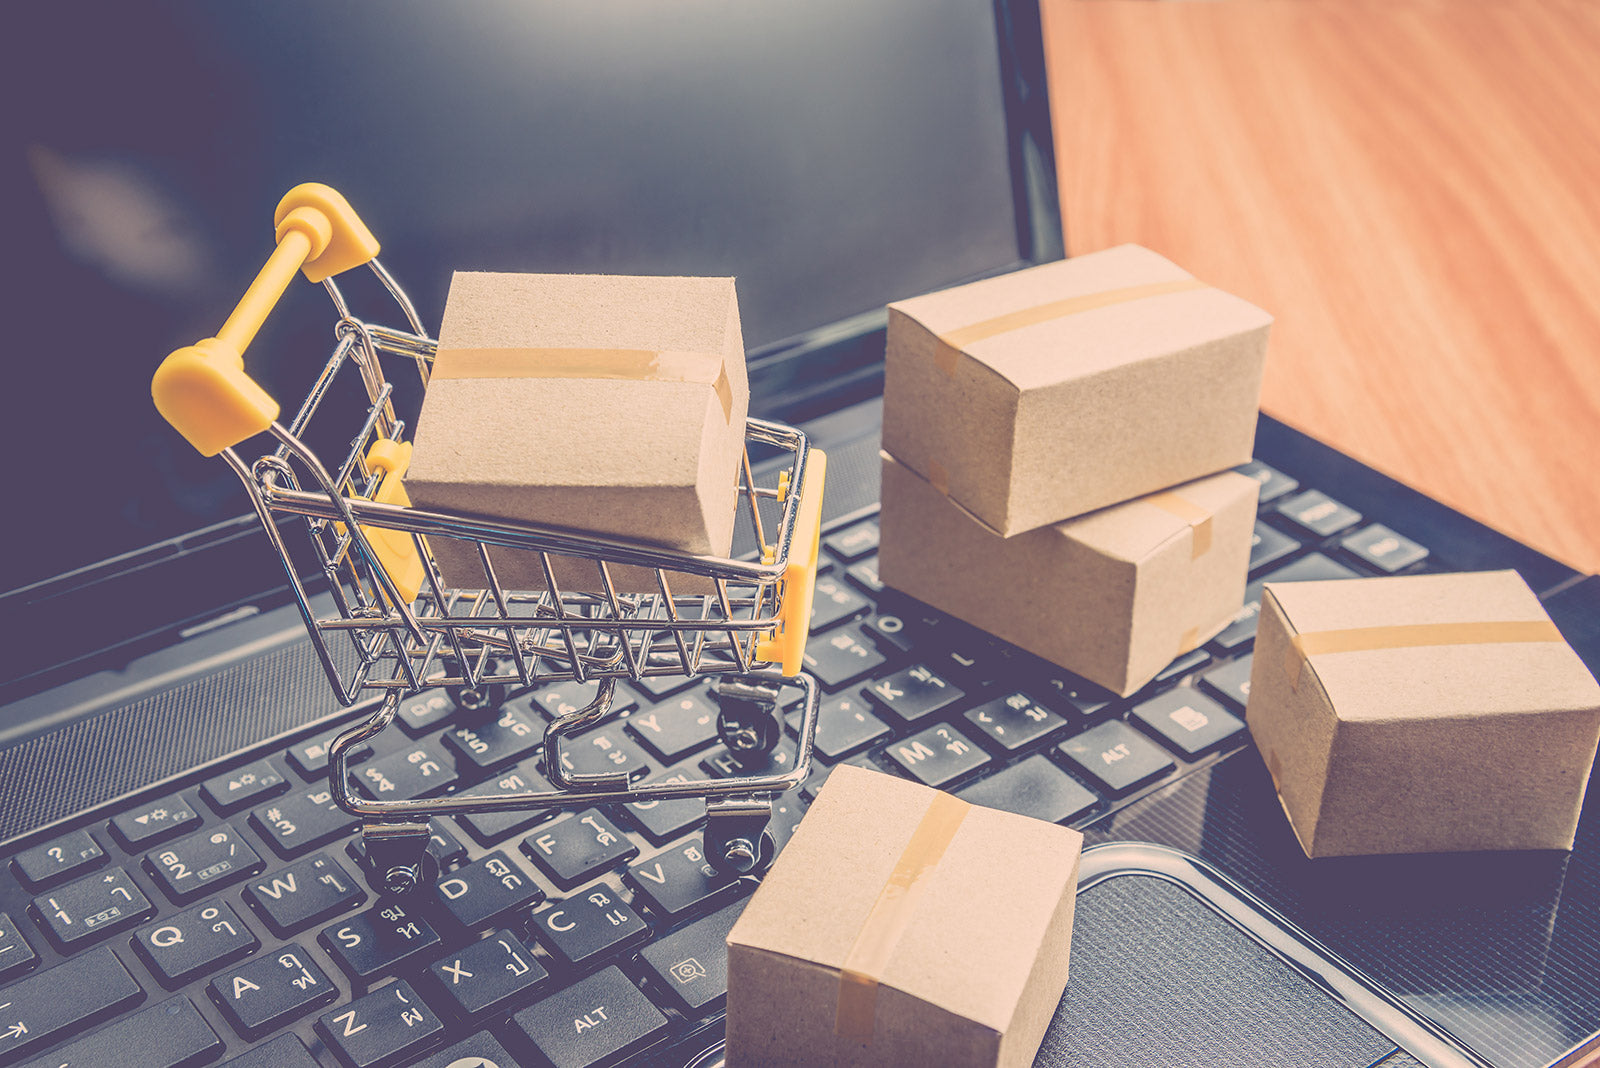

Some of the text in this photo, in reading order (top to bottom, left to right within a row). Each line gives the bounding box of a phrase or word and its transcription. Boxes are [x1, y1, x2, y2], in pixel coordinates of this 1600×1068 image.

[878, 616, 904, 633] O
[951, 652, 975, 666] L
[875, 681, 904, 701] K
[638, 714, 661, 732] Y
[468, 739, 489, 754] 5
[898, 741, 935, 765] M
[1101, 743, 1131, 765] ALT
[720, 757, 744, 775] H
[378, 777, 395, 792] 4
[266, 808, 282, 823] #
[275, 820, 297, 836] 3
[536, 834, 556, 855] F
[160, 851, 180, 866] @
[169, 863, 192, 880] 2
[639, 863, 666, 884] V
[258, 872, 297, 899] W
[438, 876, 469, 899] D
[55, 910, 72, 925] 1
[546, 910, 576, 932] C
[150, 926, 185, 947] Q
[337, 927, 361, 948] S
[441, 959, 473, 984] X
[233, 976, 261, 999] A
[332, 1010, 368, 1037] Z
[574, 1006, 608, 1034] ALT
